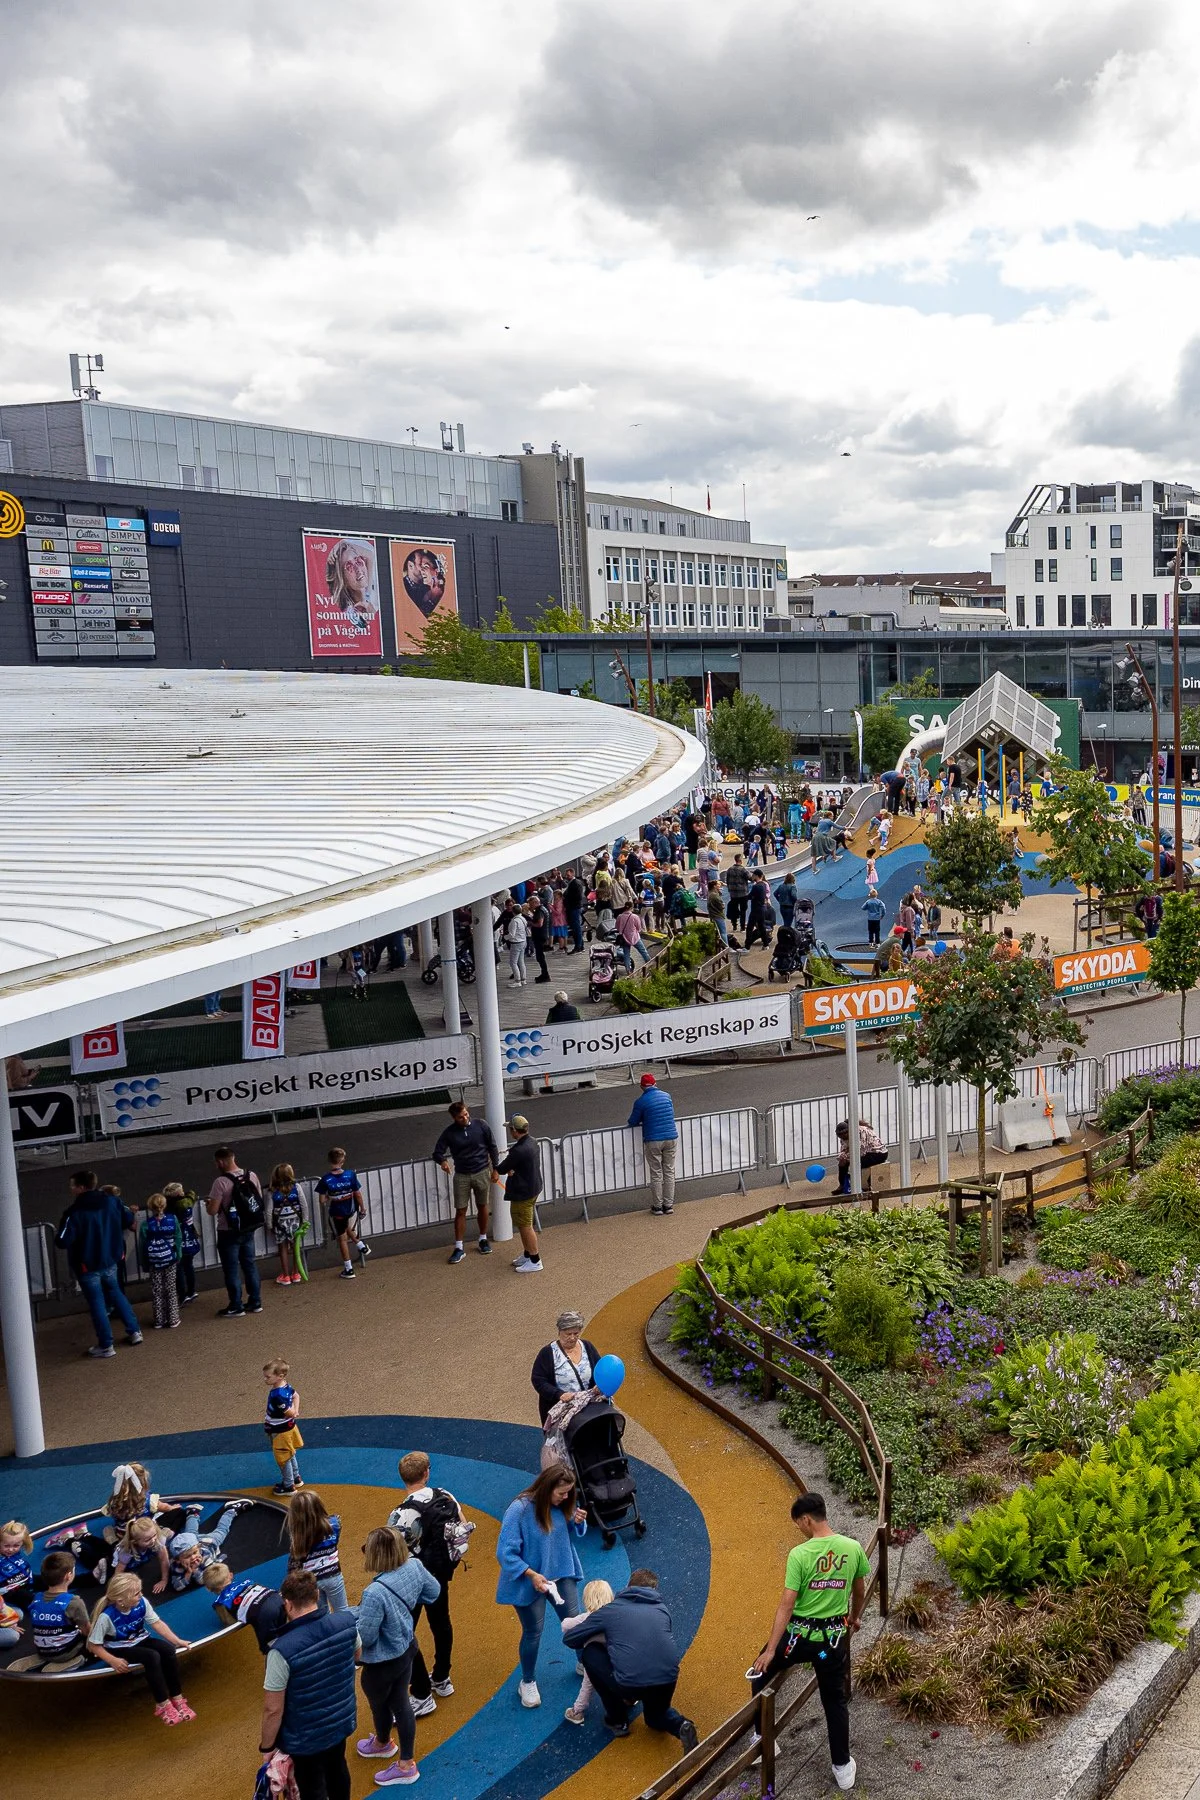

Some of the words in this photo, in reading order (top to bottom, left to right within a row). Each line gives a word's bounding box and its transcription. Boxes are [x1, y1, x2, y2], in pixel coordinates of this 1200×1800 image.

[152, 522, 180, 533] ODEON
[111, 531, 142, 540] SIMPLY
[315, 594, 336, 608] Nyt
[36, 607, 72, 615] EUROSKO
[317, 623, 332, 639] på
[333, 623, 371, 639] Vågen!
[1182, 677, 1200, 689] Din
[1061, 950, 1137, 984] SKYDDA
[1071, 981, 1106, 992] PROTECTING
[1107, 976, 1127, 986] PEOPLE
[814, 984, 918, 1022] SKYDDA
[830, 1019, 878, 1031] PROCTING
[562, 1030, 653, 1056] ProSjekt
[660, 1017, 754, 1044] Regnskap
[758, 1014, 780, 1029] as
[185, 1074, 299, 1105] ProSjekt
[308, 1060, 428, 1091] Regnskap
[431, 1055, 458, 1073] as
[38, 1613, 63, 1622] OBOS
